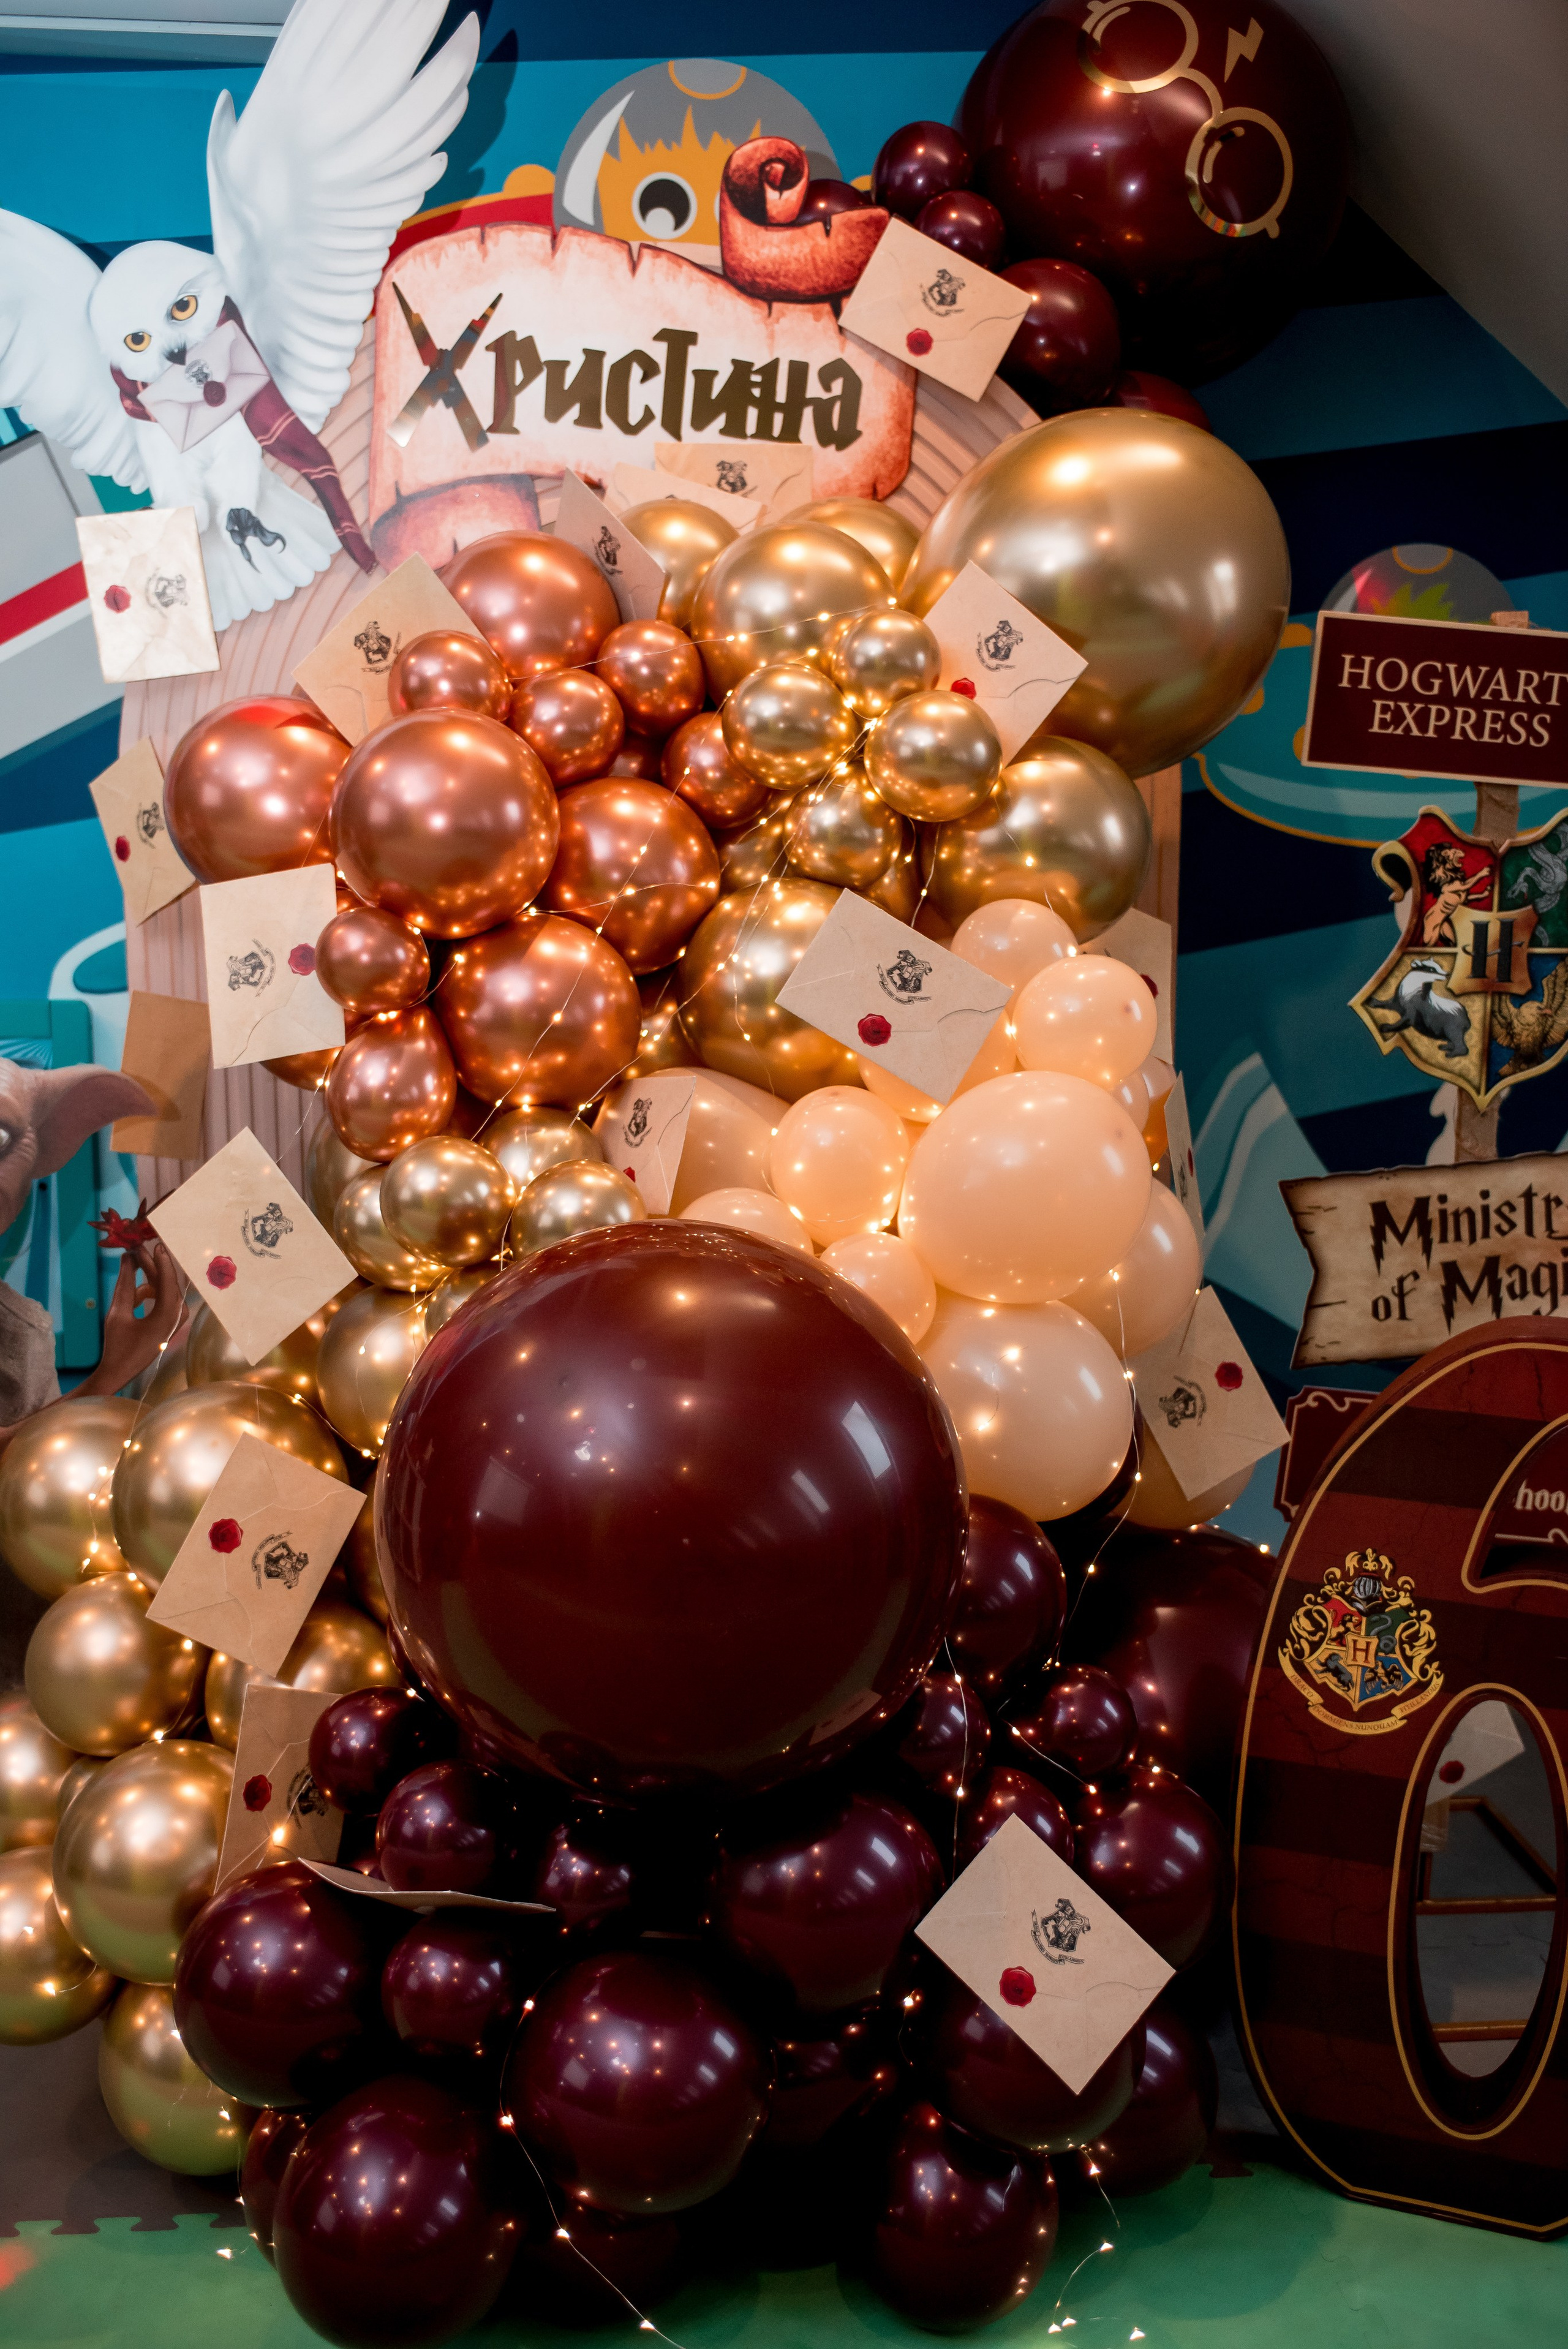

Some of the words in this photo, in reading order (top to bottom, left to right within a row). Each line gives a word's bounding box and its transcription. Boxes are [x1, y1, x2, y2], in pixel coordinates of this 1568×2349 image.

[385, 281, 863, 452] Христина
[1368, 699, 1551, 748] EXPRESS
[1369, 1182, 1568, 1276] Ministr
[1371, 1270, 1420, 1322] of
[1513, 1478, 1568, 1516] hoo
